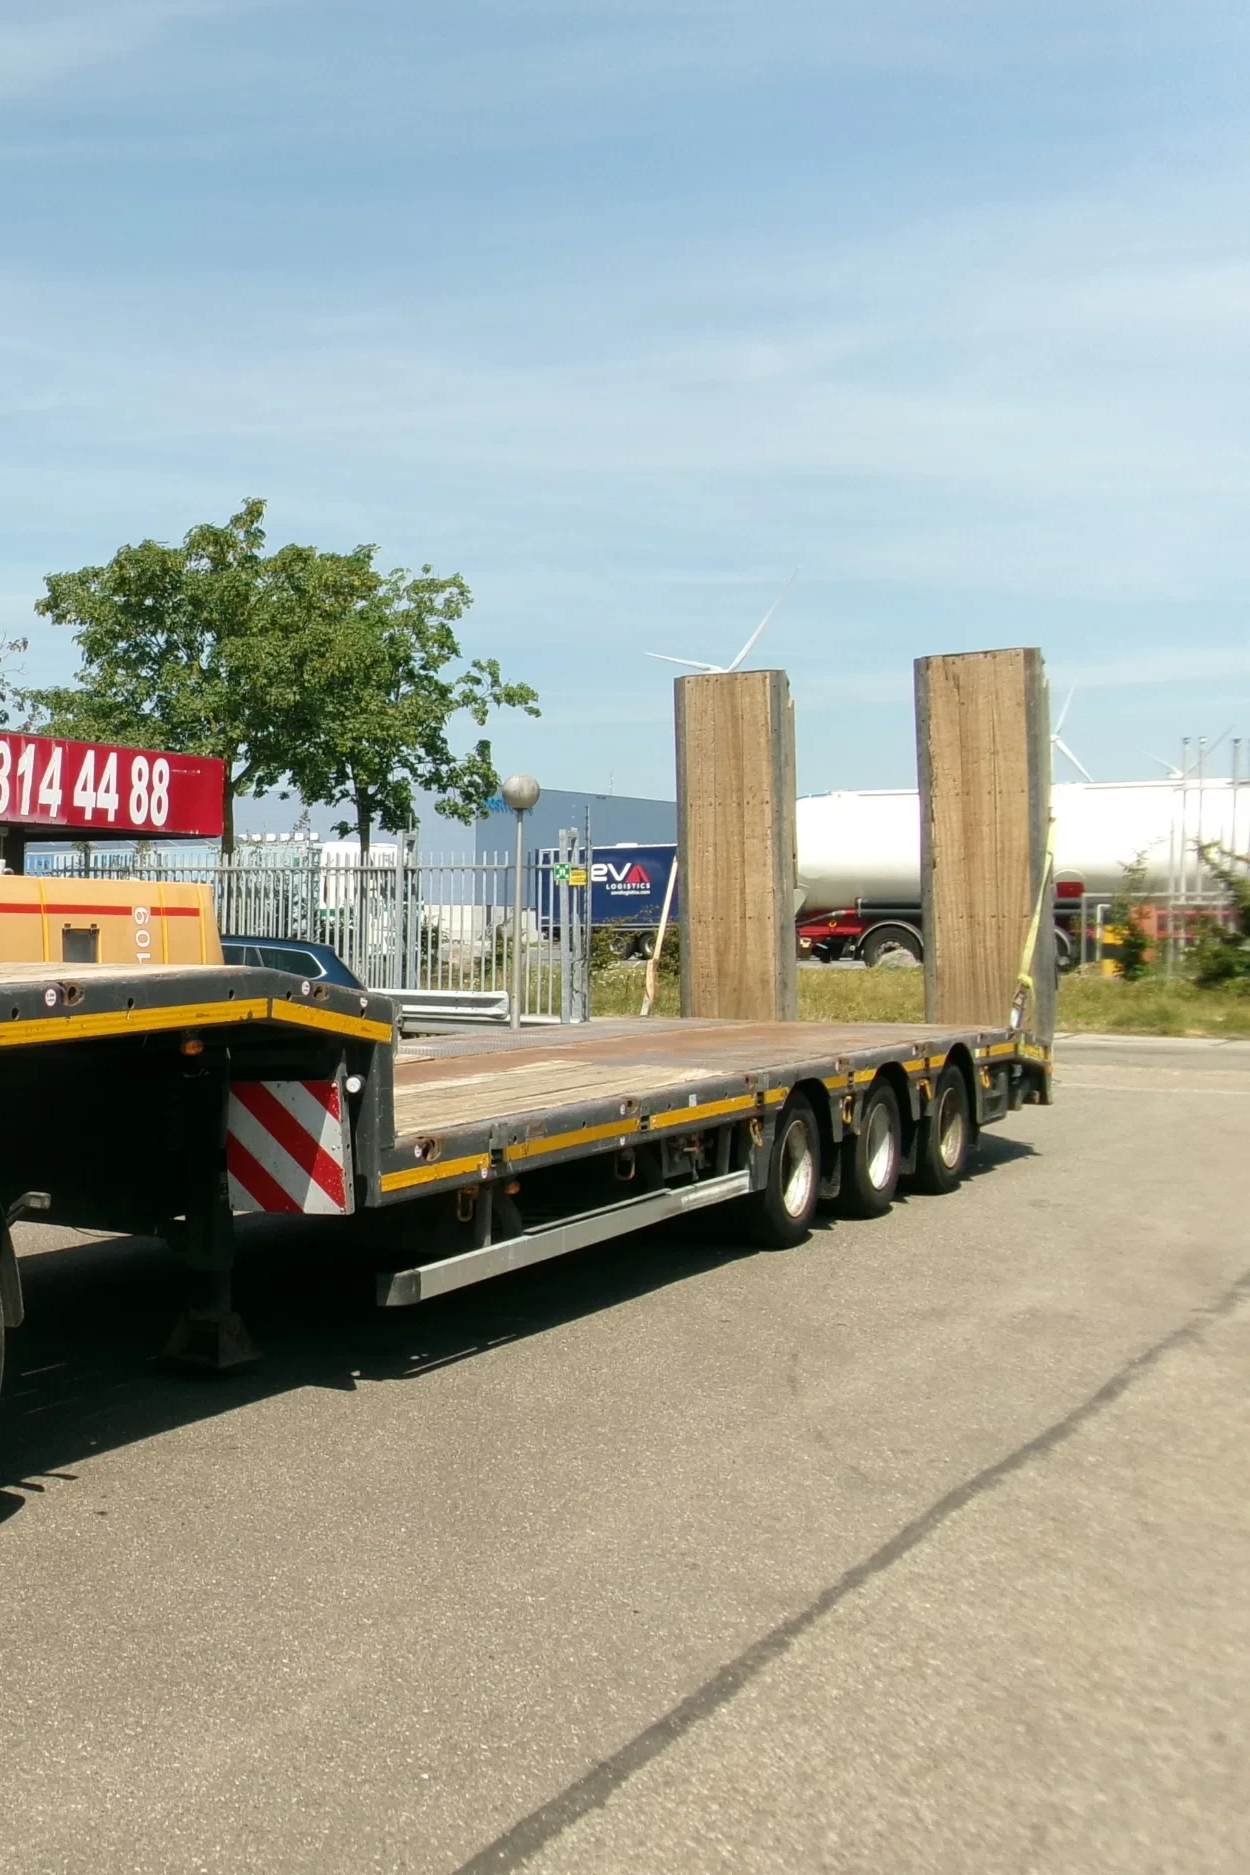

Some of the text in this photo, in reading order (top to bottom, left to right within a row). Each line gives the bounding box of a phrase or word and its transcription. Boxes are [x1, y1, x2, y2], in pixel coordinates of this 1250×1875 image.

[73, 749, 119, 822] 44
[129, 755, 170, 826] 88
[134, 906, 150, 964] 109
